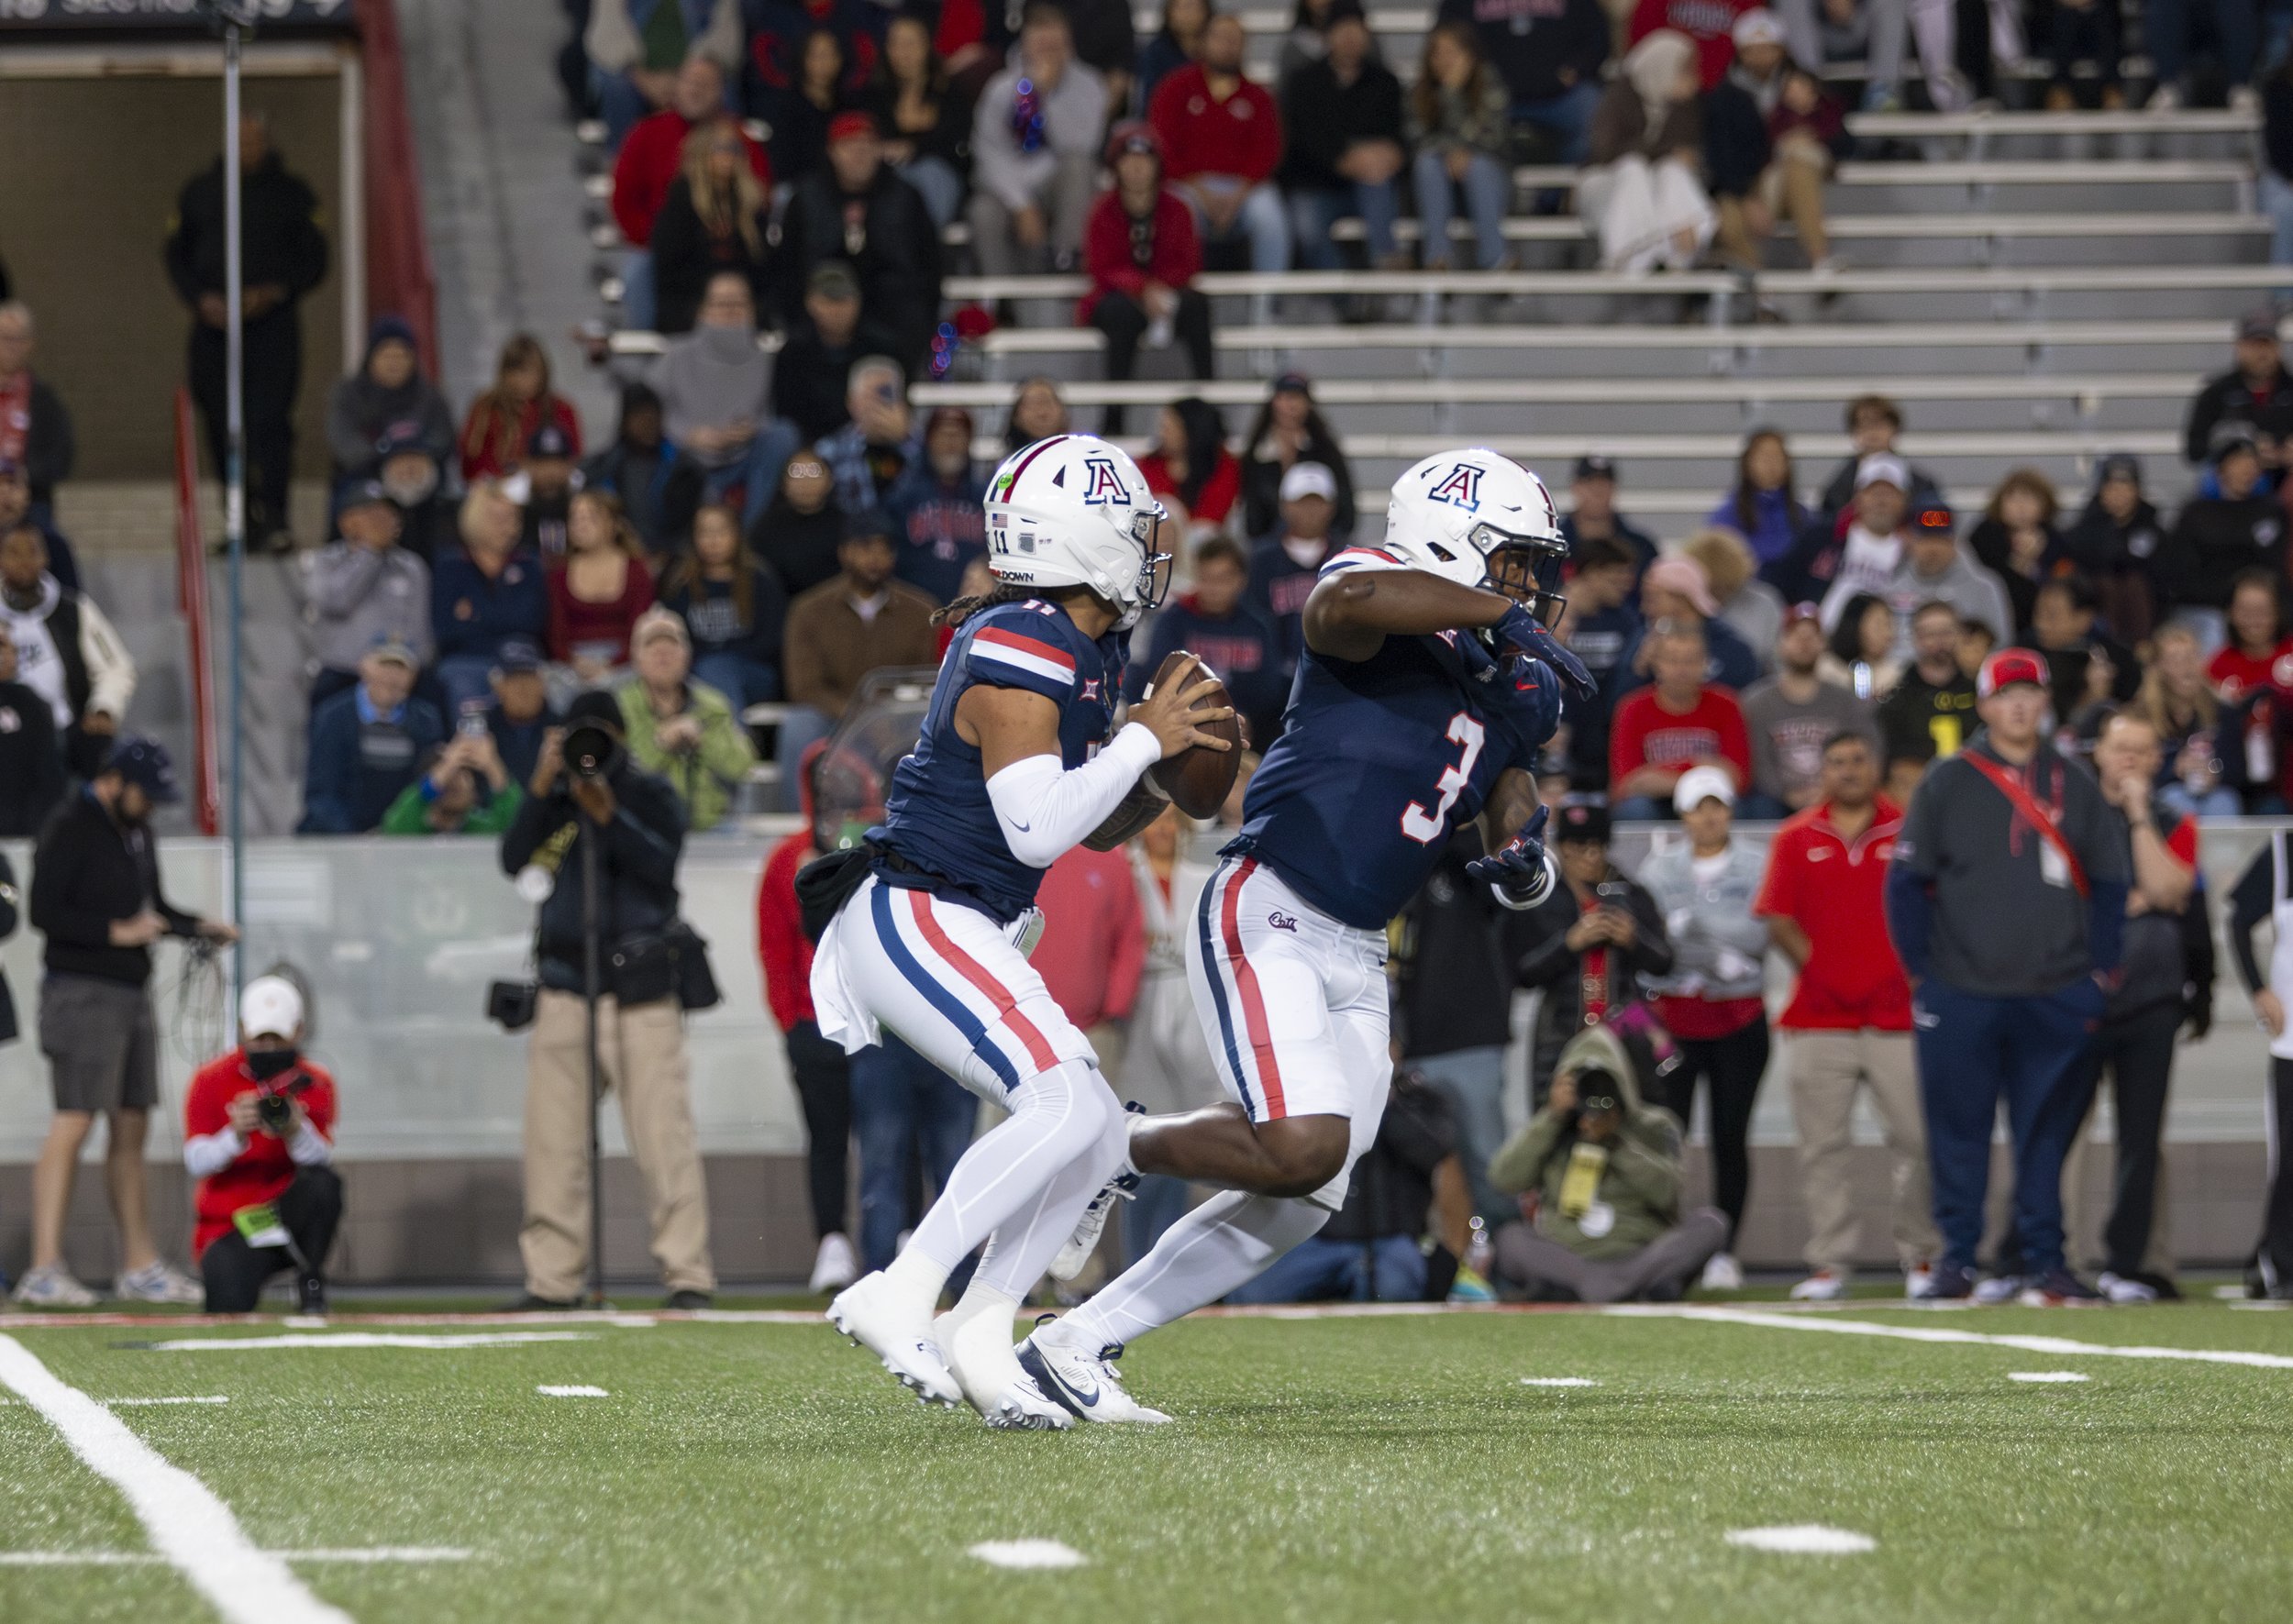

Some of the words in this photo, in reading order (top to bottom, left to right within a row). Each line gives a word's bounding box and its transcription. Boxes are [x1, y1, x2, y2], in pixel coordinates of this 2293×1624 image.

[1084, 459, 1131, 505] A
[1428, 463, 1486, 513] A
[993, 529, 1009, 554] 11
[1002, 570, 1034, 582] DOWN
[1400, 710, 1485, 845] 3
